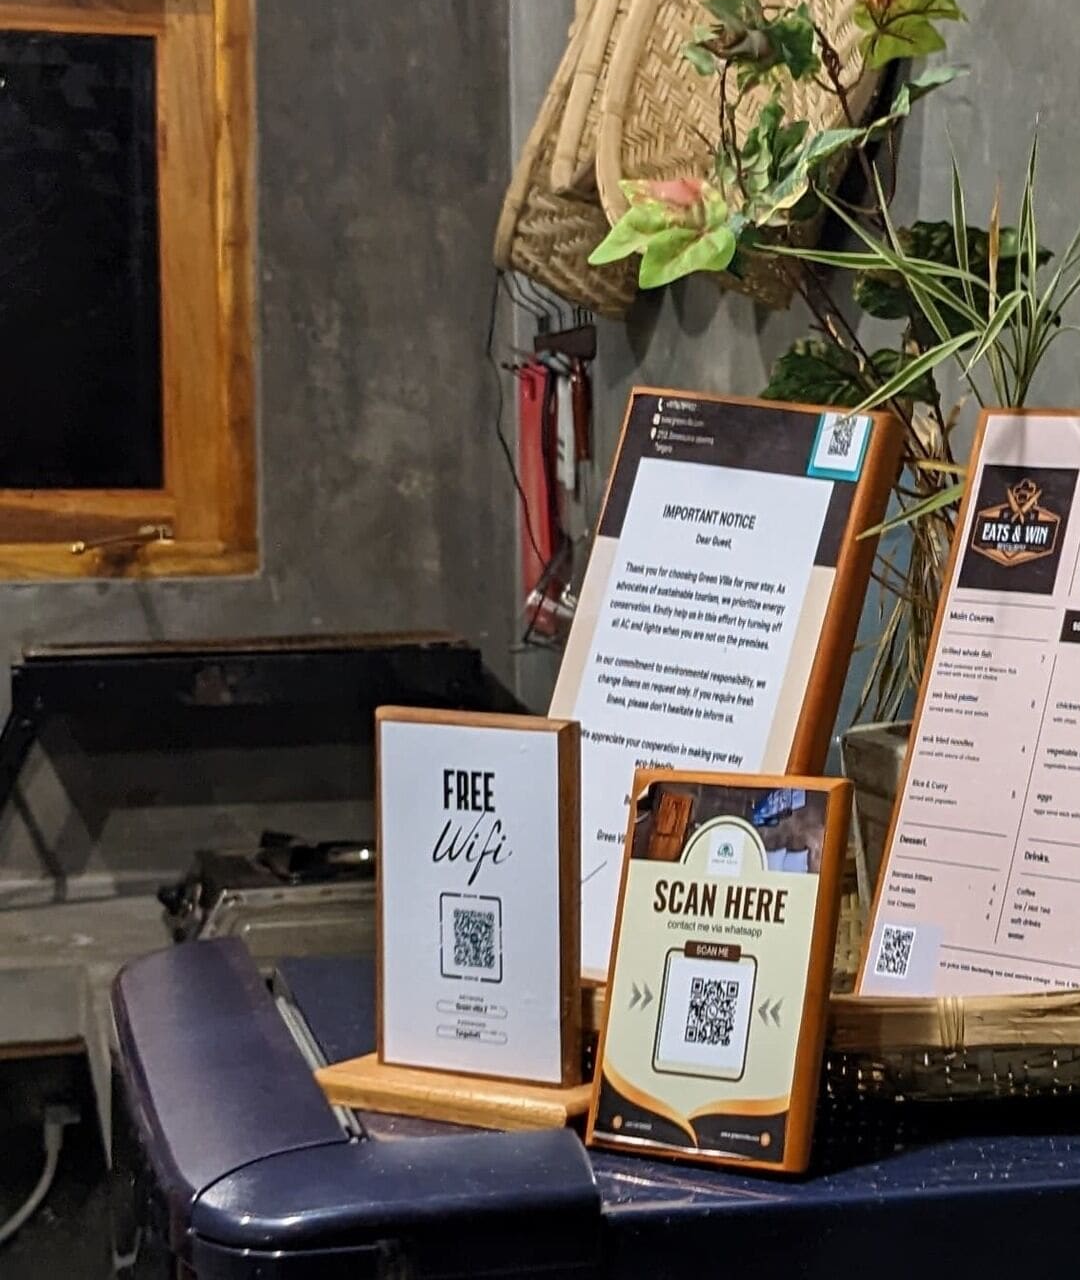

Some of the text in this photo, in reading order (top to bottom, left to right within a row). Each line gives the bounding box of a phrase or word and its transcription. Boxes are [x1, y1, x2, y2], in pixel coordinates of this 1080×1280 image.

[663, 504, 756, 530] IMPORTANT NOTICE
[696, 534, 732, 550] Dear Guest,
[982, 523, 1048, 544] EATS & WIN
[626, 562, 644, 575] Thank
[645, 567, 658, 577] you
[658, 567, 668, 577] for
[669, 569, 697, 584] choosing
[698, 572, 718, 585] Green
[719, 575, 732, 586] Villa
[734, 577, 744, 588] for
[744, 581, 759, 591] your
[776, 584, 785, 594] As
[616, 582, 648, 594] advocates
[650, 585, 657, 595] of
[657, 587, 693, 600] sustainable
[722, 596, 731, 605] we
[731, 596, 761, 610] prioritize
[762, 602, 786, 615] energy
[653, 604, 672, 618] Kindly
[674, 608, 687, 620] help
[688, 612, 696, 620] us
[697, 611, 704, 621] in
[705, 612, 717, 623] this
[718, 614, 737, 626] effort
[737, 617, 746, 629] by
[747, 618, 770, 633] turning
[771, 622, 783, 632] off
[950, 611, 967, 620] Main
[612, 619, 620, 628] all
[620, 620, 630, 630] AC
[631, 622, 642, 631] and
[643, 621, 662, 635] lights
[663, 626, 679, 637] when
[680, 628, 692, 640] you
[693, 631, 704, 640] are
[705, 632, 716, 642] not
[716, 634, 726, 643] on
[726, 634, 737, 645] the
[596, 654, 602, 663] In
[603, 657, 615, 666] our
[615, 657, 655, 672] commitment
[656, 663, 663, 672] to
[663, 664, 709, 679] environmental
[756, 680, 766, 689] we
[598, 675, 621, 688] change
[621, 677, 640, 689] linens
[641, 681, 650, 690] on
[651, 682, 676, 696] request
[692, 687, 699, 697] If
[699, 691, 711, 701] you
[711, 692, 736, 704] require
[736, 694, 754, 706] fresh
[627, 697, 648, 711] please
[650, 701, 667, 713] don't
[667, 704, 693, 717] hesitate
[695, 709, 702, 718] to
[702, 710, 724, 722] inform
[591, 732, 743, 766] appreciate your cooperation in making your stay
[443, 769, 495, 812] FREE
[932, 781, 948, 792] Curry
[433, 812, 512, 886] Wifi
[597, 829, 616, 843] Green
[654, 879, 788, 924] SCAN HERE
[668, 920, 695, 931] contact
[712, 924, 722, 932] via
[725, 926, 762, 938] whatsapp
[696, 945, 729, 957] SCAN ME
